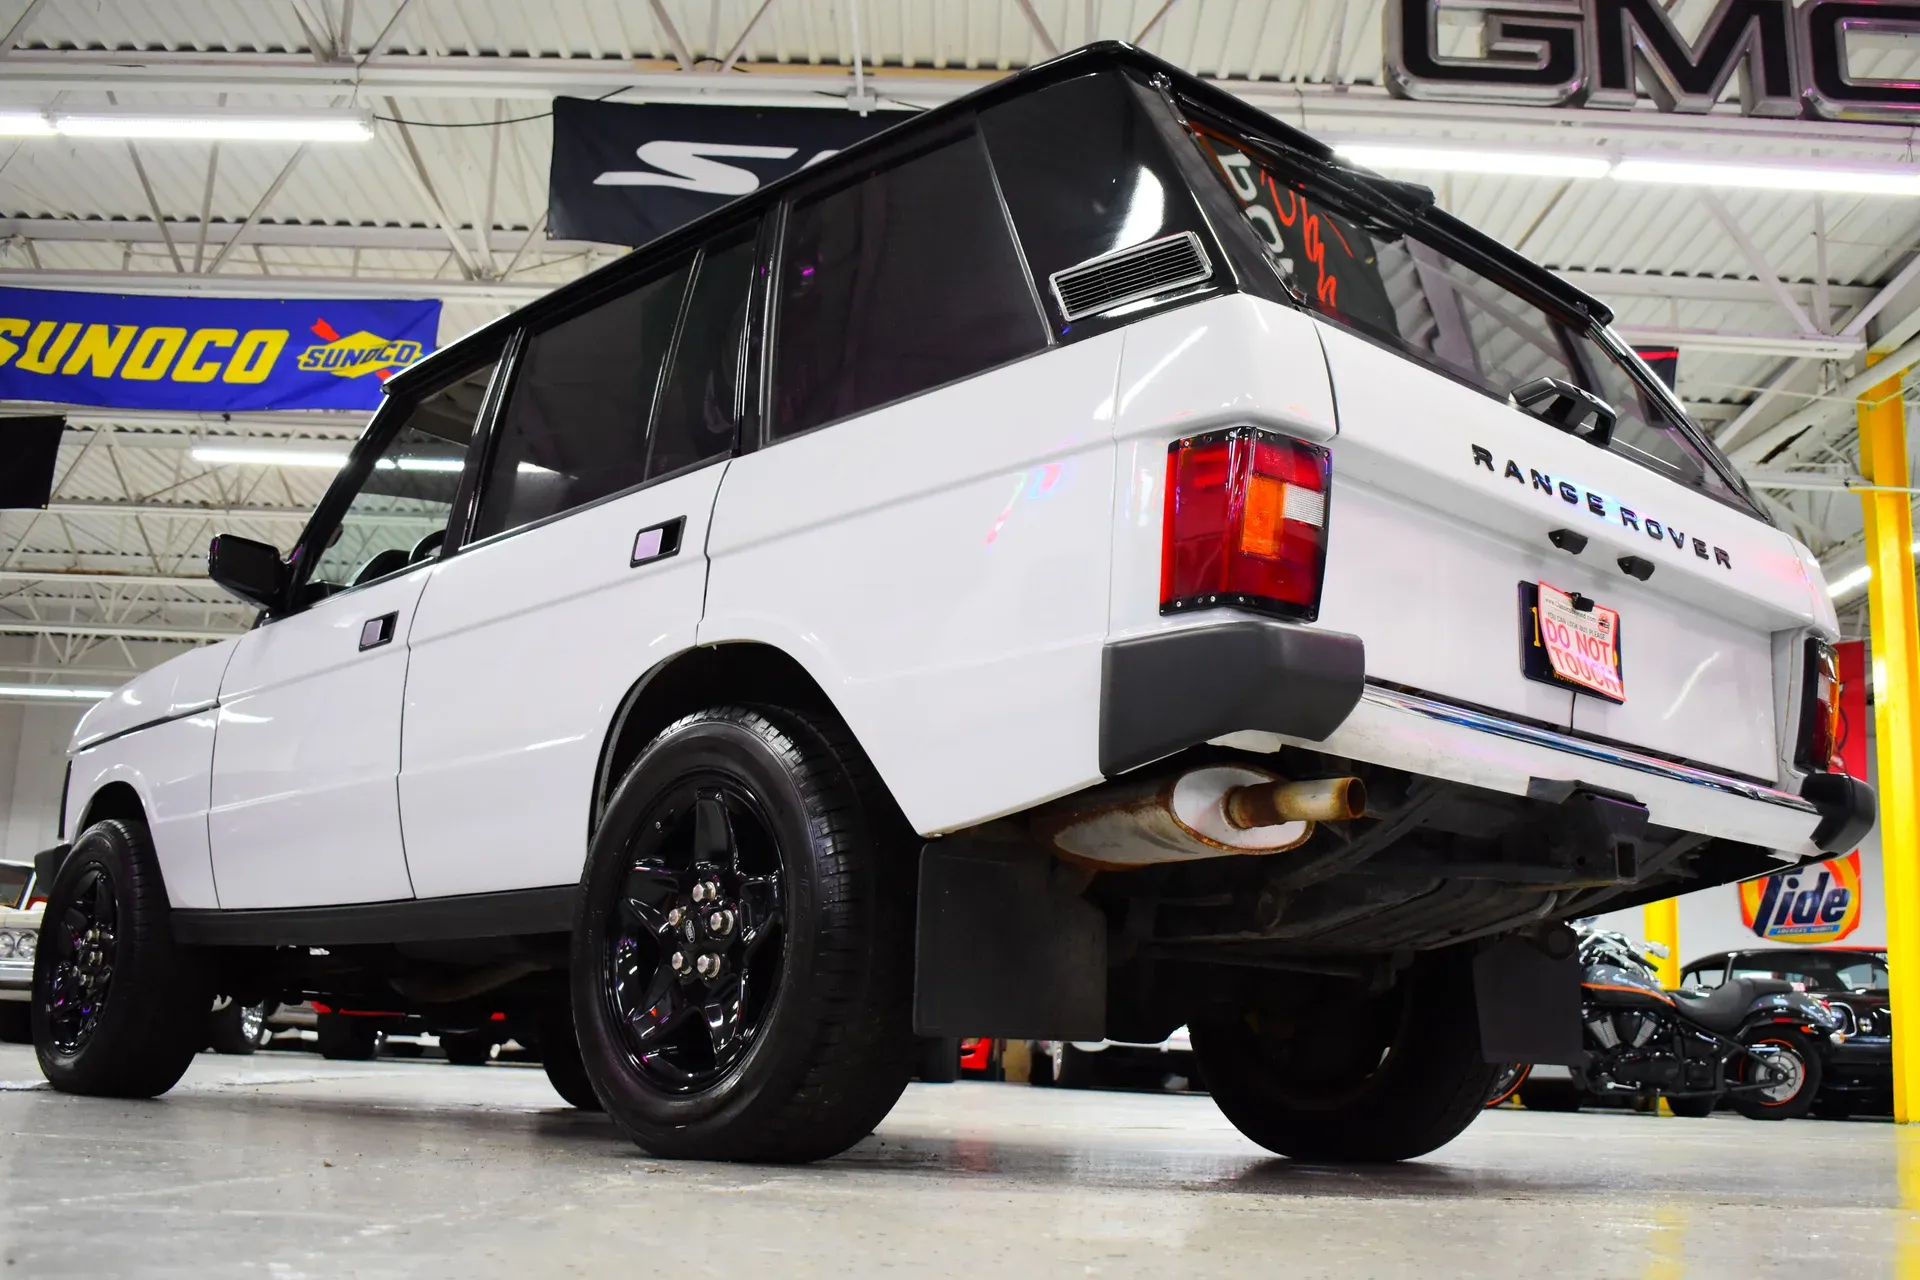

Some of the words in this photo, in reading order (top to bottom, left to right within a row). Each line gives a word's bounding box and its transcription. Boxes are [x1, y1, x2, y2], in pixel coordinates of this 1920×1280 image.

[1383, 0, 1920, 125] GMC
[303, 342, 420, 369] SUNOCO
[1471, 443, 1606, 517] RANGE
[1620, 506, 1732, 570] ROVER
[1545, 618, 1570, 648] DO
[1575, 630, 1610, 665] NOT
[1551, 646, 1618, 693] TOUCH
[1752, 866, 1851, 938] Tide
